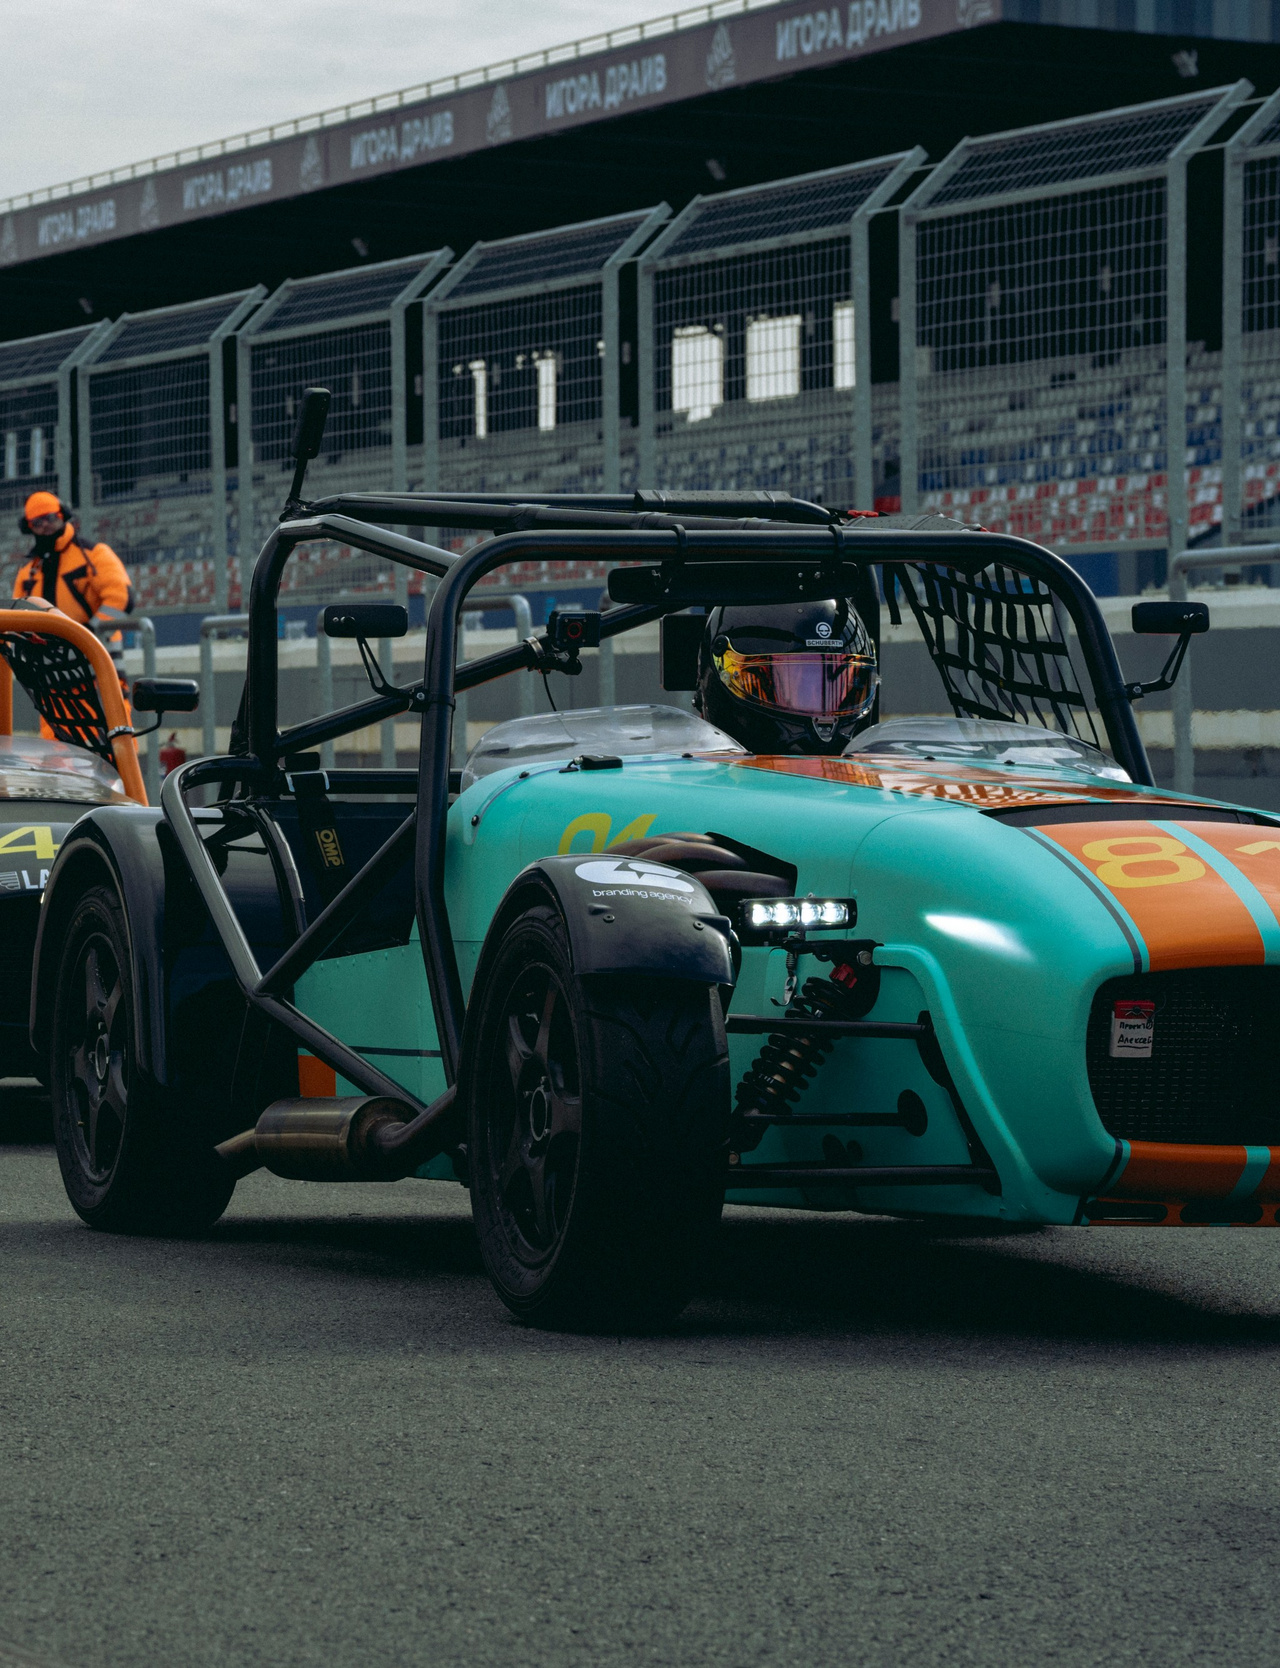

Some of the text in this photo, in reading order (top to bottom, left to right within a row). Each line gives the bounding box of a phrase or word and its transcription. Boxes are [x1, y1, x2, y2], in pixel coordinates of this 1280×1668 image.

[776, 8, 843, 61] ИГОРА
[545, 70, 601, 118] ИГОРА
[319, 829, 341, 867] OMP
[592, 888, 693, 905] branding agency
